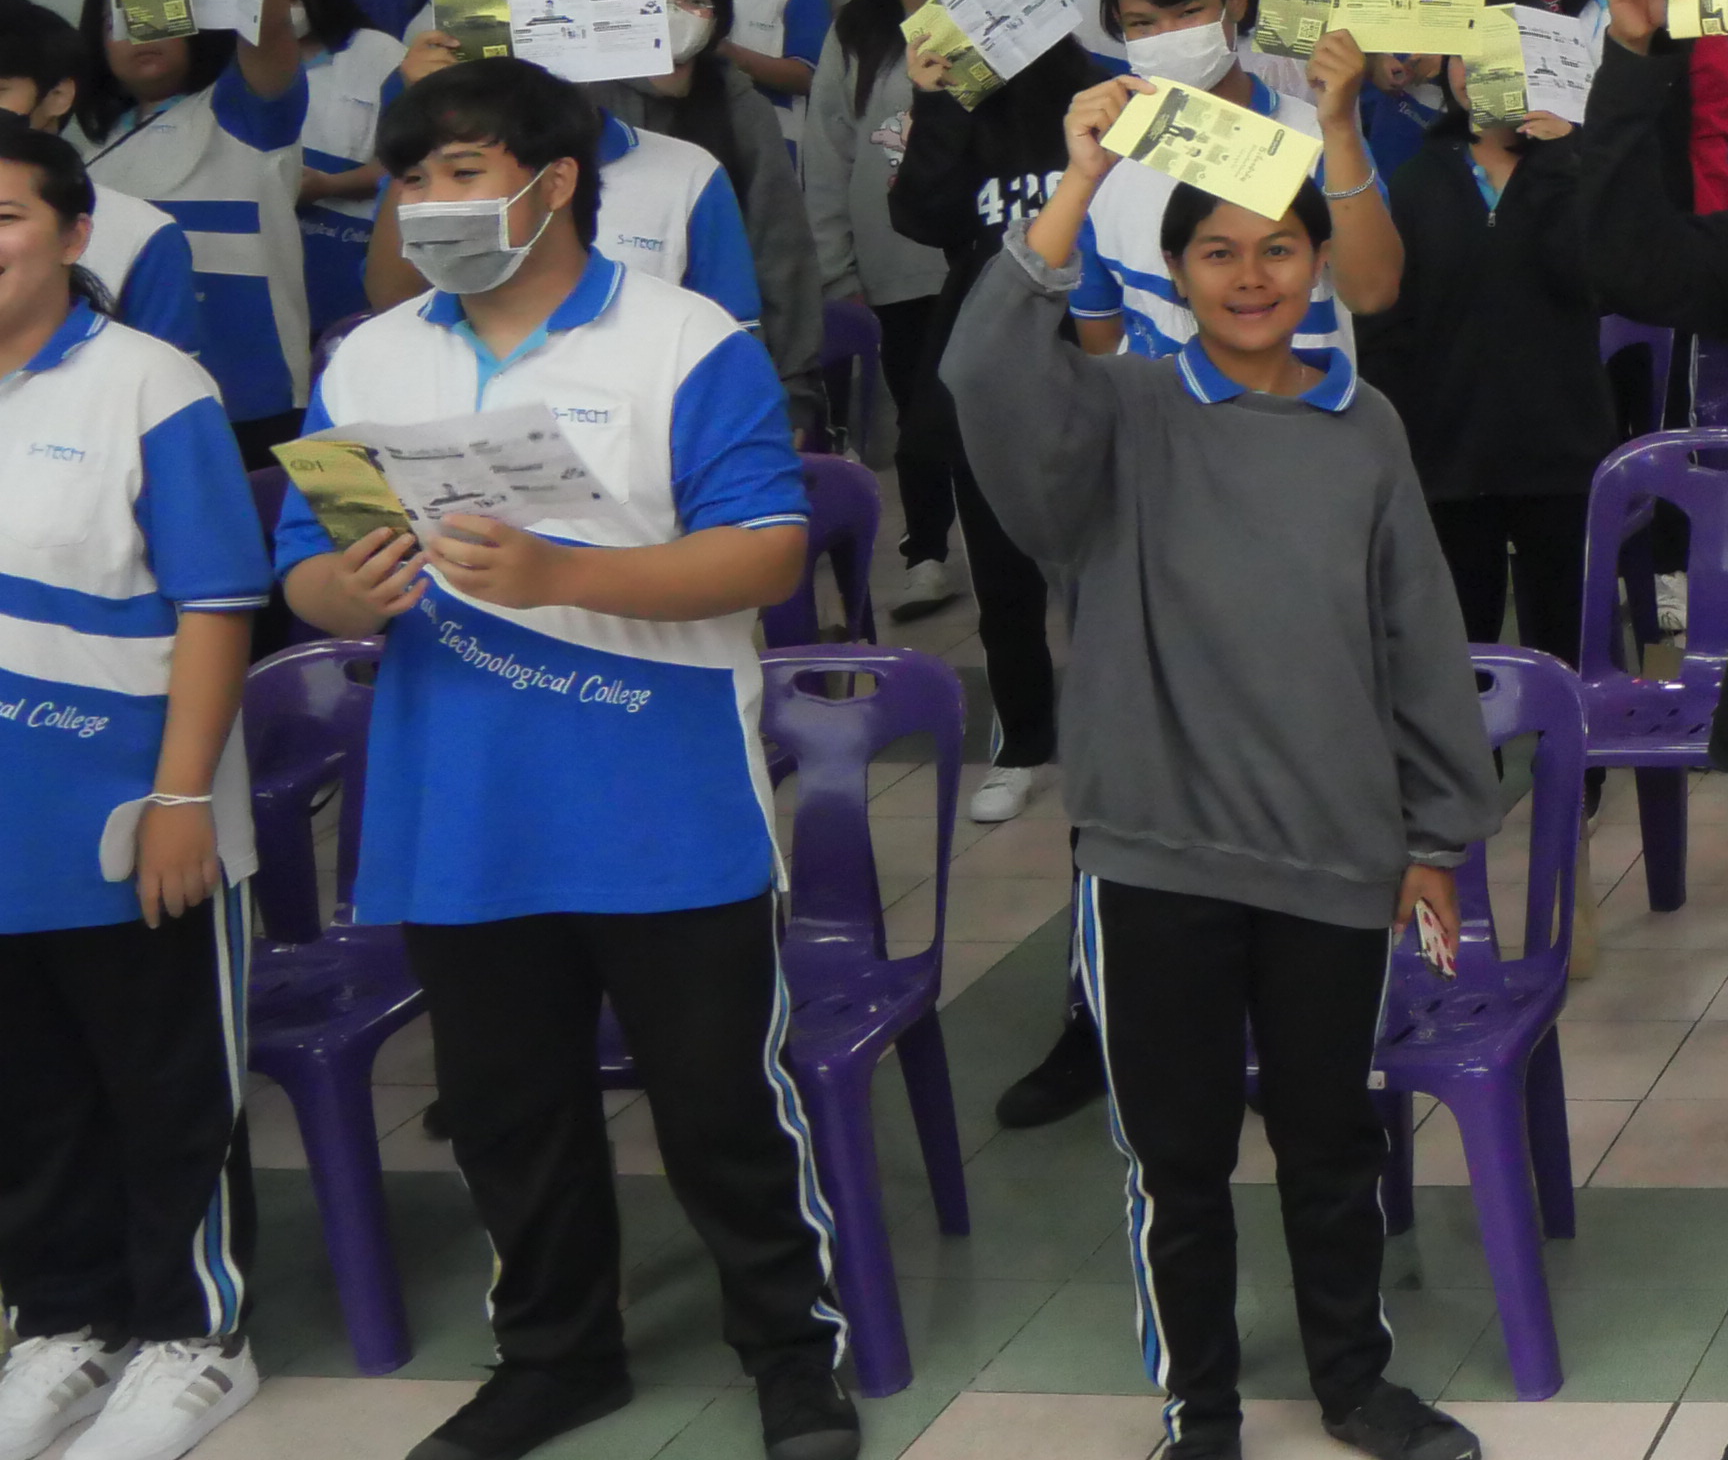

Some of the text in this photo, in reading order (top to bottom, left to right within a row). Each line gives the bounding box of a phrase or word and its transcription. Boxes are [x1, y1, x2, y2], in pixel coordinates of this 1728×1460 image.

[26, 442, 86, 462] S-TECH
[437, 620, 652, 713] Technological College
[27, 701, 110, 738] College
